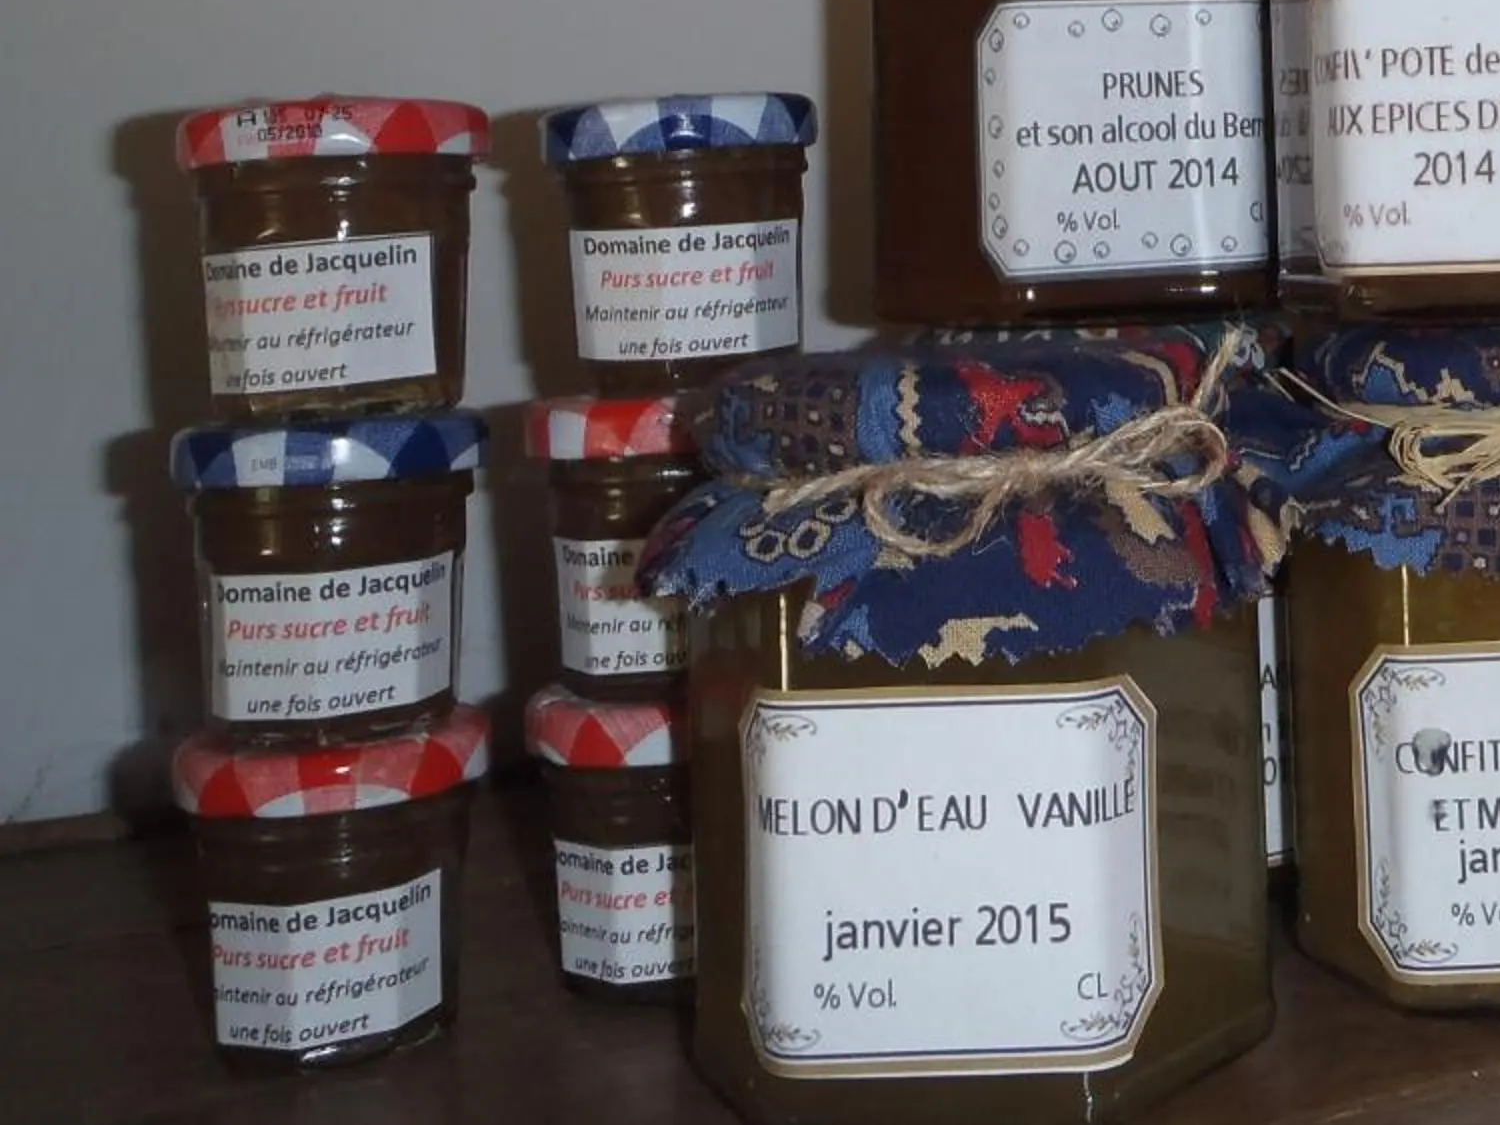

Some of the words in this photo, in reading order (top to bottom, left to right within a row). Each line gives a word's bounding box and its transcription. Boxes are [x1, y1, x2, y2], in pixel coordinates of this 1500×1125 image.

[1381, 44, 1453, 78] POTE
[1465, 42, 1500, 75] de
[1103, 70, 1204, 99] PRUNES
[1016, 122, 1041, 147] et
[1047, 124, 1093, 144] son
[1102, 114, 1176, 143] alcool
[1185, 113, 1215, 139] du
[1327, 104, 1363, 137] AUX
[1371, 100, 1470, 134] EPICES
[1072, 161, 1157, 193] AOUT
[1168, 157, 1238, 189] 2014
[1413, 149, 1496, 187] 2014
[584, 235, 671, 255] Domaine
[678, 233, 706, 252] de
[712, 226, 790, 253] Jacquelin
[269, 255, 298, 276] de
[306, 245, 417, 273] Jacquelin
[600, 269, 641, 289] Purs
[645, 270, 703, 288] sucre
[710, 265, 732, 283] et
[736, 261, 774, 286] fruit
[302, 287, 327, 309] et
[332, 283, 390, 312] fruit
[585, 304, 660, 323] Maintenir
[665, 306, 688, 320] au
[257, 332, 281, 350] au
[287, 320, 415, 350] réfrigérateur
[619, 339, 648, 355] une
[650, 338, 683, 357] fois
[688, 333, 749, 352] ouvert
[281, 363, 348, 385] ouvert
[319, 579, 351, 600] de
[358, 562, 446, 597] Jacquelin
[227, 619, 278, 641] Purs
[282, 619, 348, 638] sucre
[354, 612, 380, 632] et
[383, 602, 431, 634] fruit
[629, 618, 652, 633] au
[303, 657, 329, 675] au
[614, 651, 647, 671] fois
[247, 695, 282, 714] une
[284, 694, 322, 717] fois
[328, 686, 396, 710] ouvert
[758, 795, 861, 835] MELON
[1017, 778, 1137, 829] VANILLE
[1430, 798, 1470, 832] ET
[558, 850, 614, 875] omaine
[620, 855, 650, 875] de
[211, 910, 280, 933] omaine
[286, 912, 318, 933] de
[325, 882, 431, 928] Jacquelin
[609, 929, 631, 944] au
[822, 907, 963, 961] janvier
[975, 902, 1072, 947] 2015
[211, 944, 252, 967] Purs
[255, 948, 315, 971] sucre
[322, 940, 349, 964] et
[353, 927, 410, 963] fruit
[275, 990, 298, 1006] au
[305, 956, 429, 1005] réfrigérateur
[575, 956, 597, 973] une
[600, 957, 625, 979] fois
[1077, 972, 1109, 1000] CL
[229, 1025, 259, 1042] une
[262, 1024, 292, 1045] fois
[298, 1013, 370, 1043] ouvert
